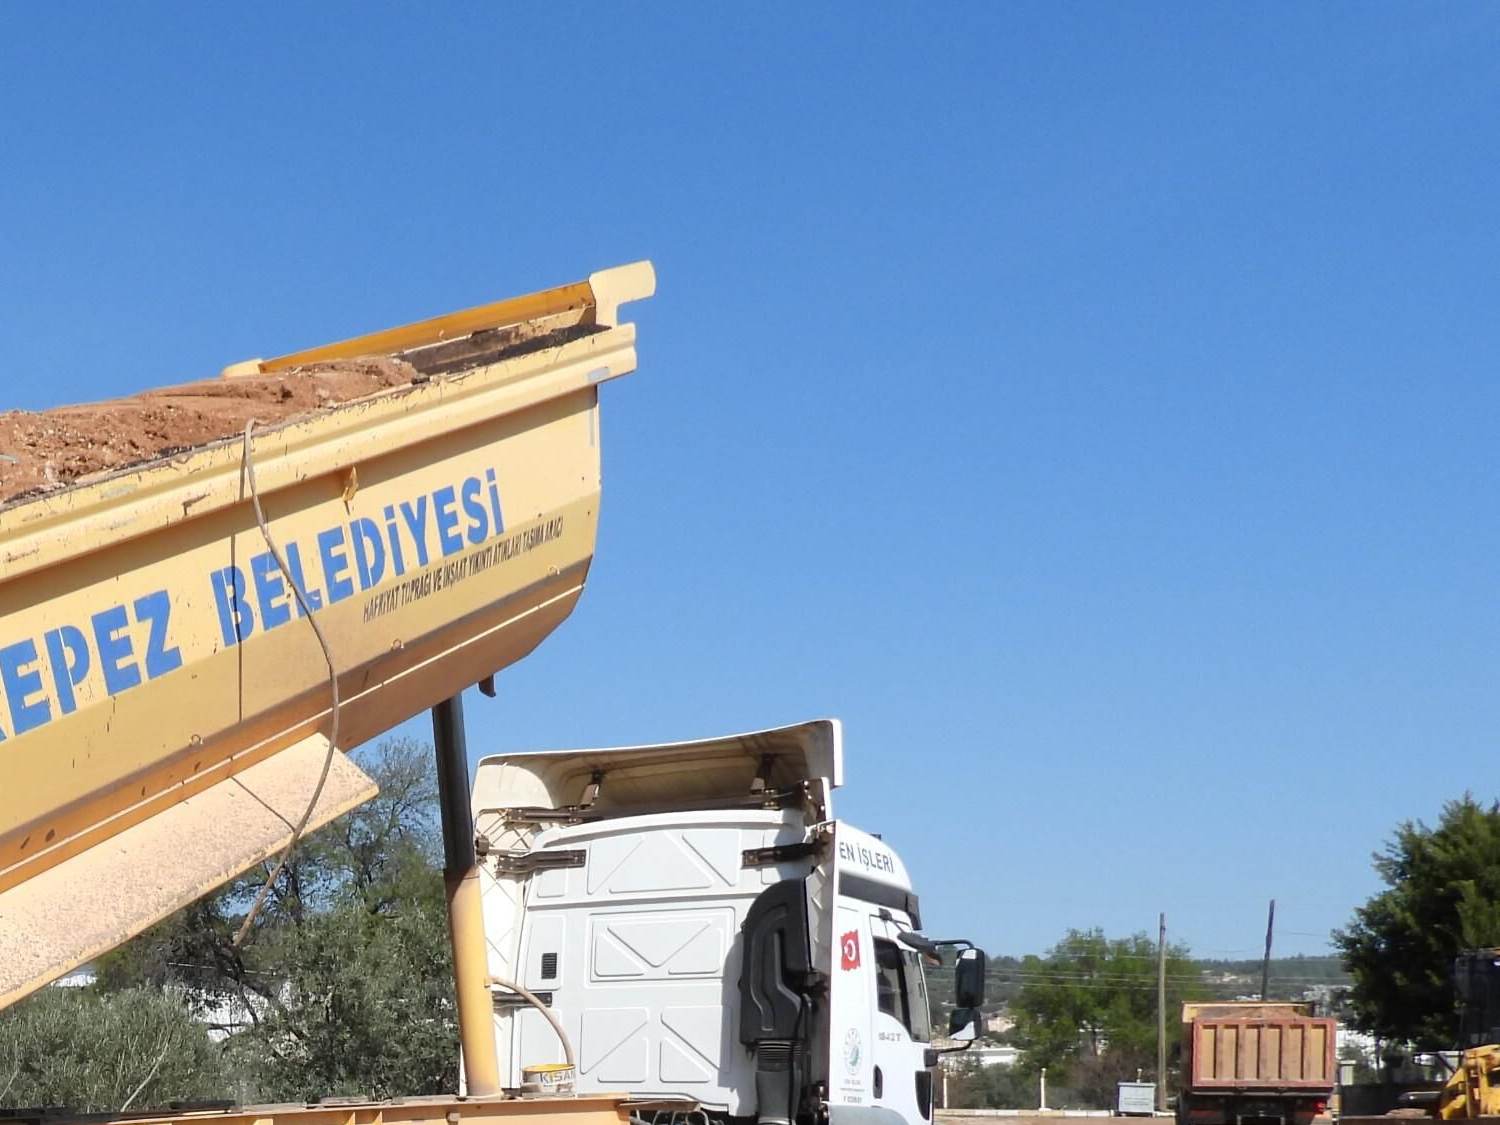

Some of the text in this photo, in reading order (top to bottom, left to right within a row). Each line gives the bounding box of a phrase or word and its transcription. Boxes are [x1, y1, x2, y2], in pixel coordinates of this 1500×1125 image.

[210, 467, 505, 648] BELEDİYESİ
[433, 567, 443, 592] VE
[857, 842, 895, 873] İŞLERİ
